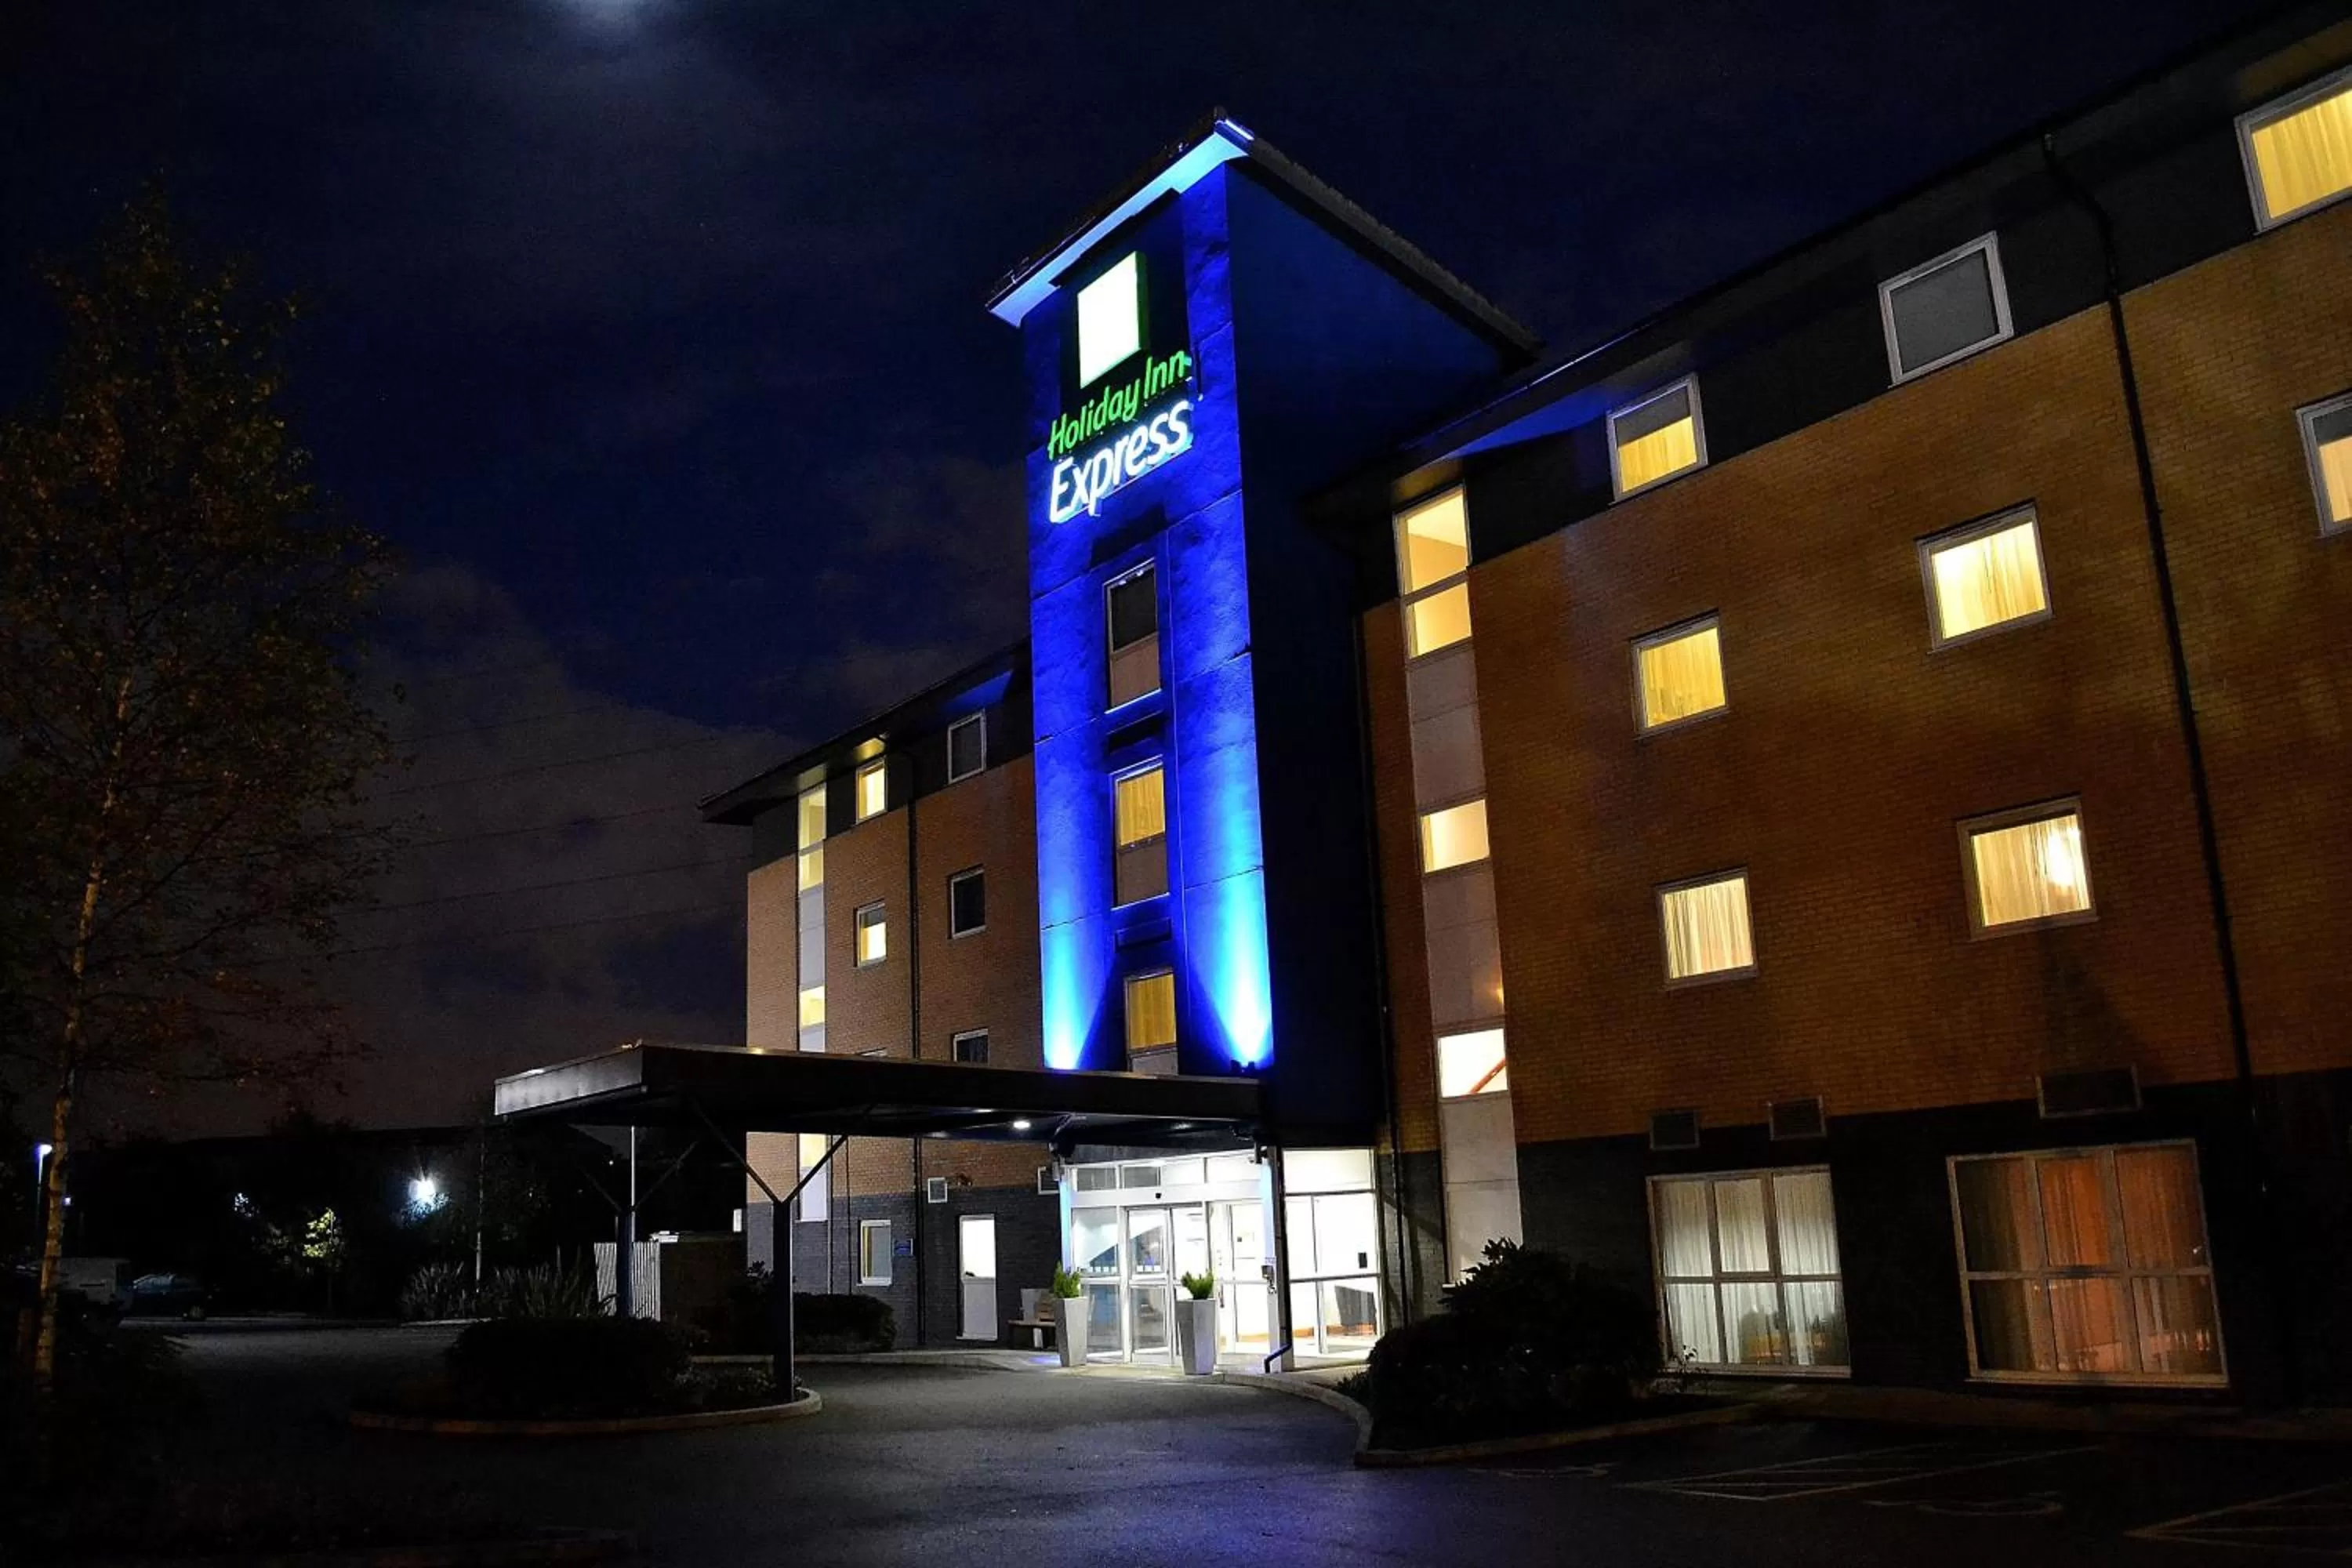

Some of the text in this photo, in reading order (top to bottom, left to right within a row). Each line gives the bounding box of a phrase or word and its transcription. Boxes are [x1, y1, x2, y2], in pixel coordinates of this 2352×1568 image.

[1048, 350, 1187, 459] Holiday Inn
[1049, 400, 1193, 524] Express
